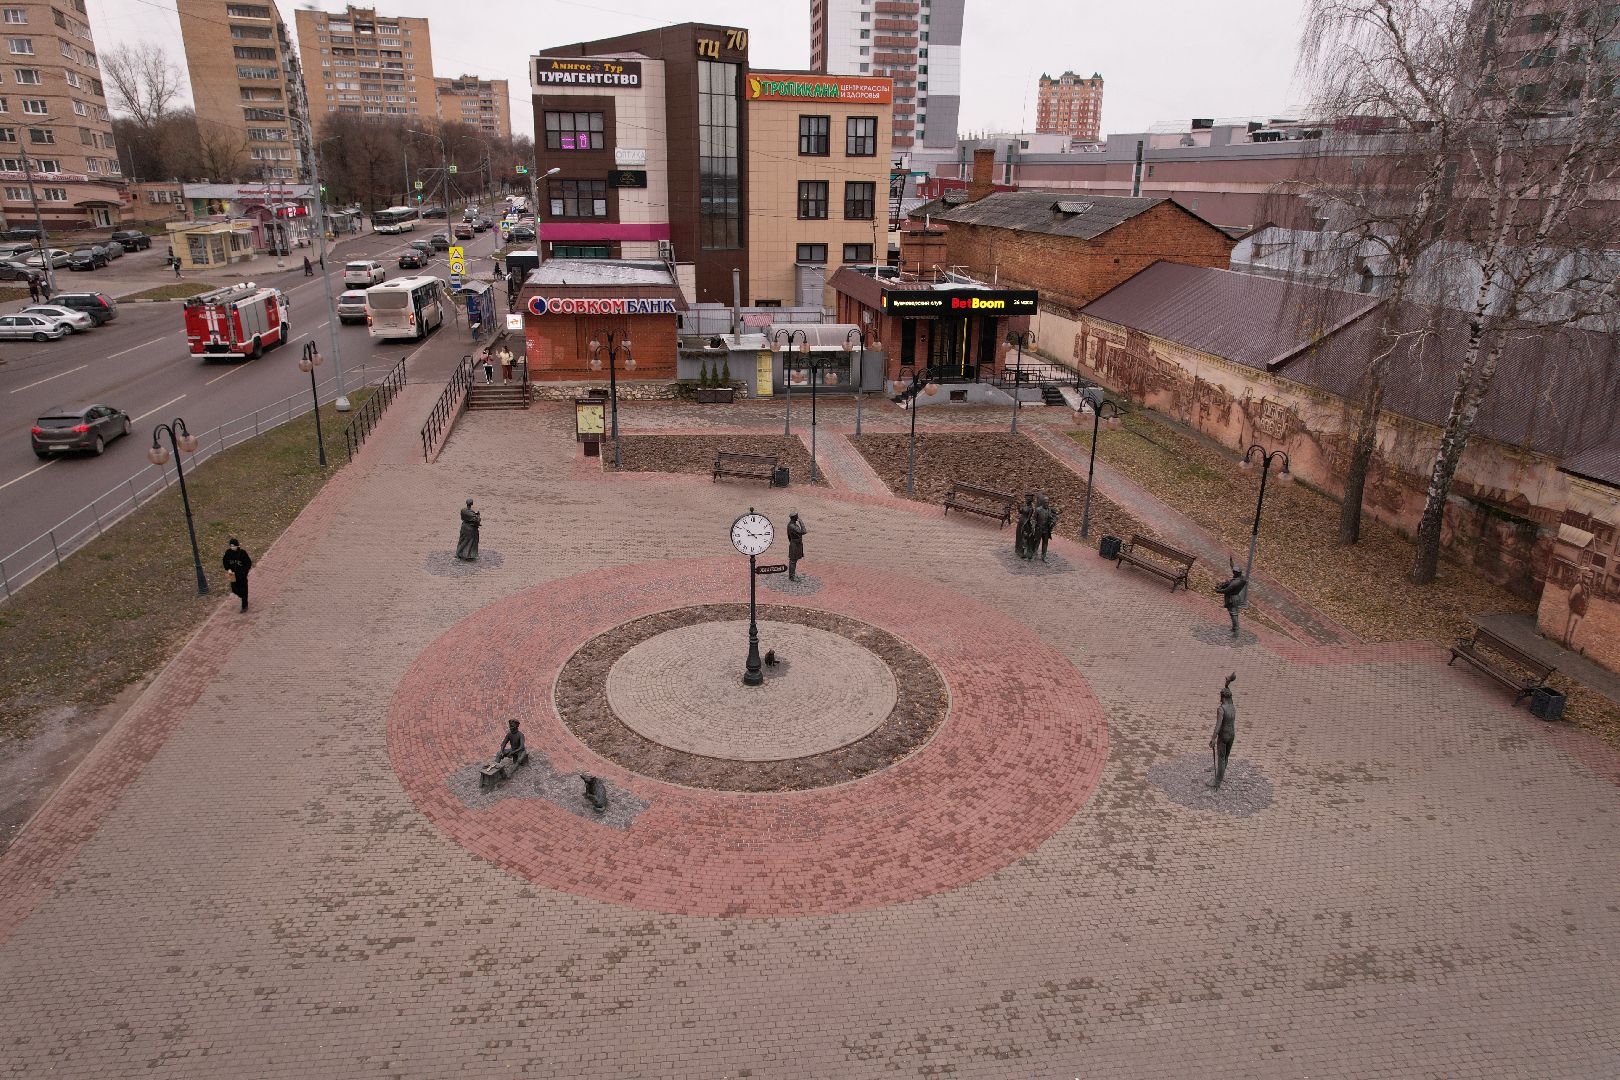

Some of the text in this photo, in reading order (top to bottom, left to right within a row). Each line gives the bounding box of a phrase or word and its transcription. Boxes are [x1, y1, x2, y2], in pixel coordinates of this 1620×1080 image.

[697, 30, 747, 59] ТЦ 70
[551, 61, 623, 73] Амигос Тур
[539, 71, 638, 85] ТУРАГЕНТСТВО
[761, 81, 840, 98] ТРОПИКАНА
[615, 150, 645, 160] ОПТИКА
[548, 298, 677, 314] СОВКОМБАНК
[951, 297, 1005, 309] BetBoom
